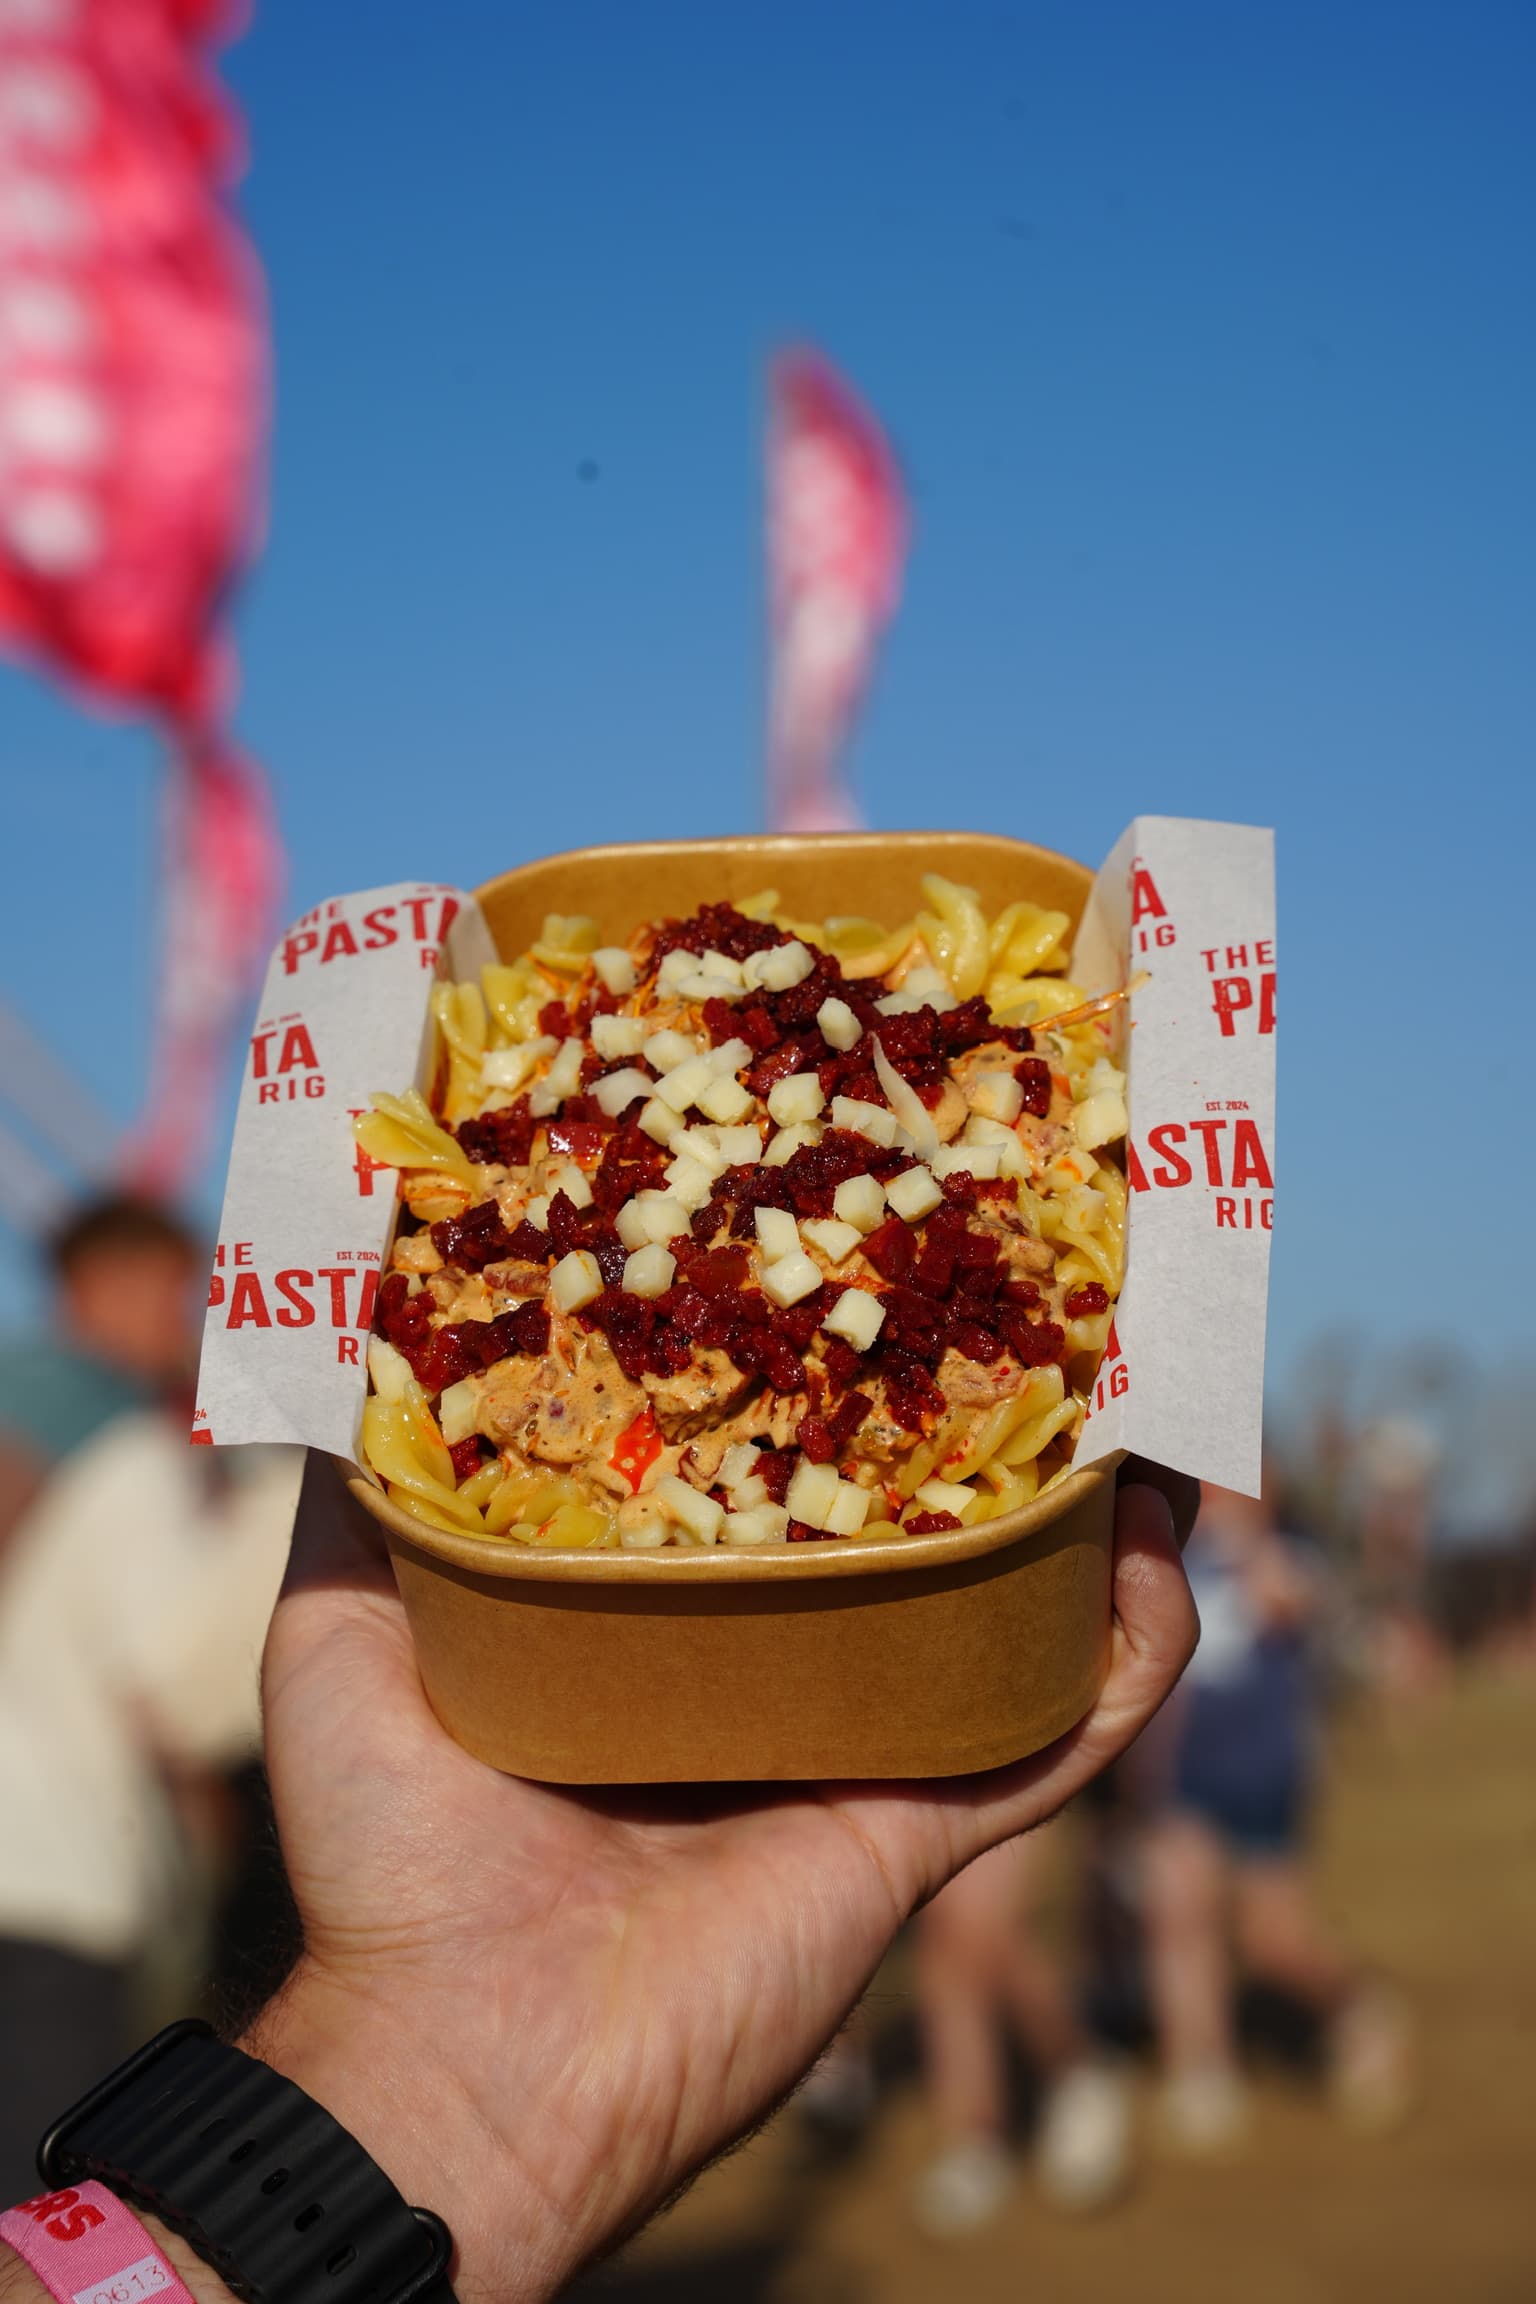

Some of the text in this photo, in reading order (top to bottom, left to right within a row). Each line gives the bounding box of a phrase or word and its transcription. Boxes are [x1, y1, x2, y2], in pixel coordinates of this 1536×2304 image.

[1201, 940, 1275, 973] THE
[259, 1075, 325, 1104] RIG
[1206, 1100, 1249, 1111] EST. 2024
[336, 1251, 381, 1262] EST. 2024
